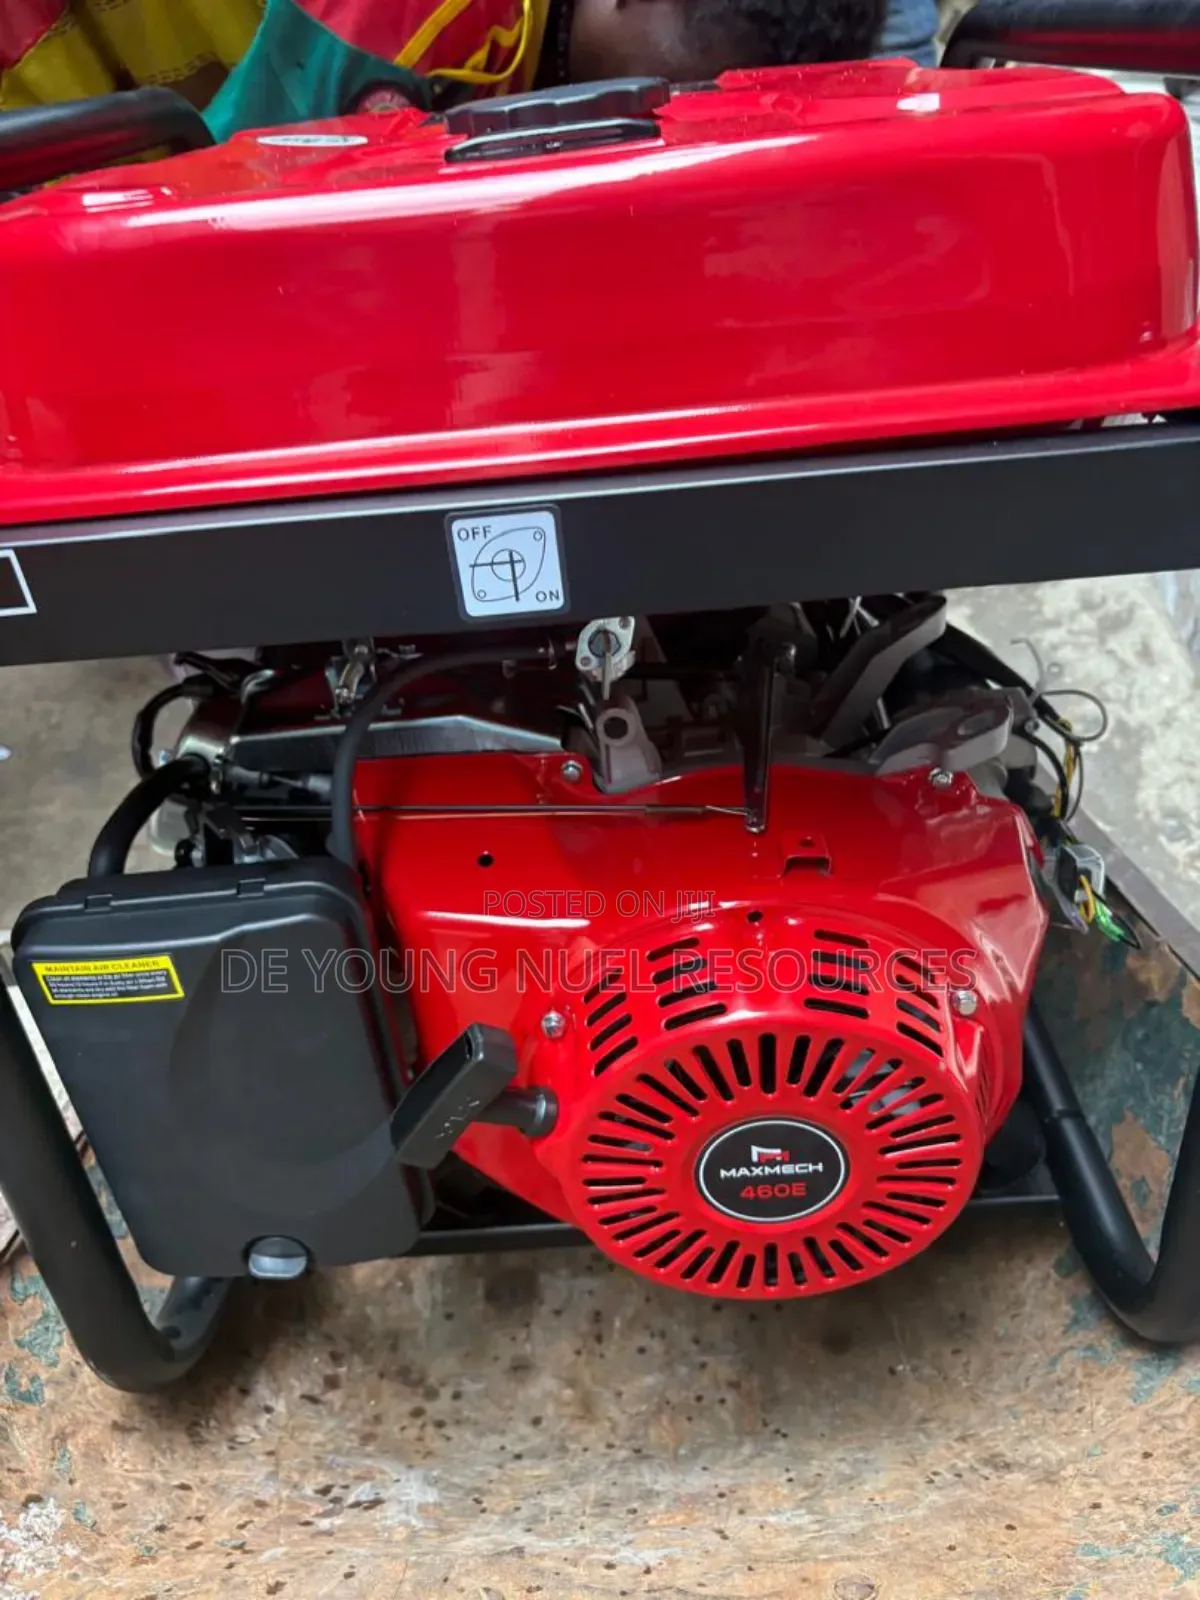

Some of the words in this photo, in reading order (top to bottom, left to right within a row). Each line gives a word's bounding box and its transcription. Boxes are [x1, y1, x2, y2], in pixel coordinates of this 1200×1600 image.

[457, 525, 492, 541] OFF
[535, 589, 561, 603] ON
[44, 964, 91, 973] MAINTAIN
[93, 963, 110, 971] AIR
[111, 959, 160, 970] CLEANER
[720, 1162, 823, 1180] MAXMECH
[740, 1182, 807, 1201] 460E
